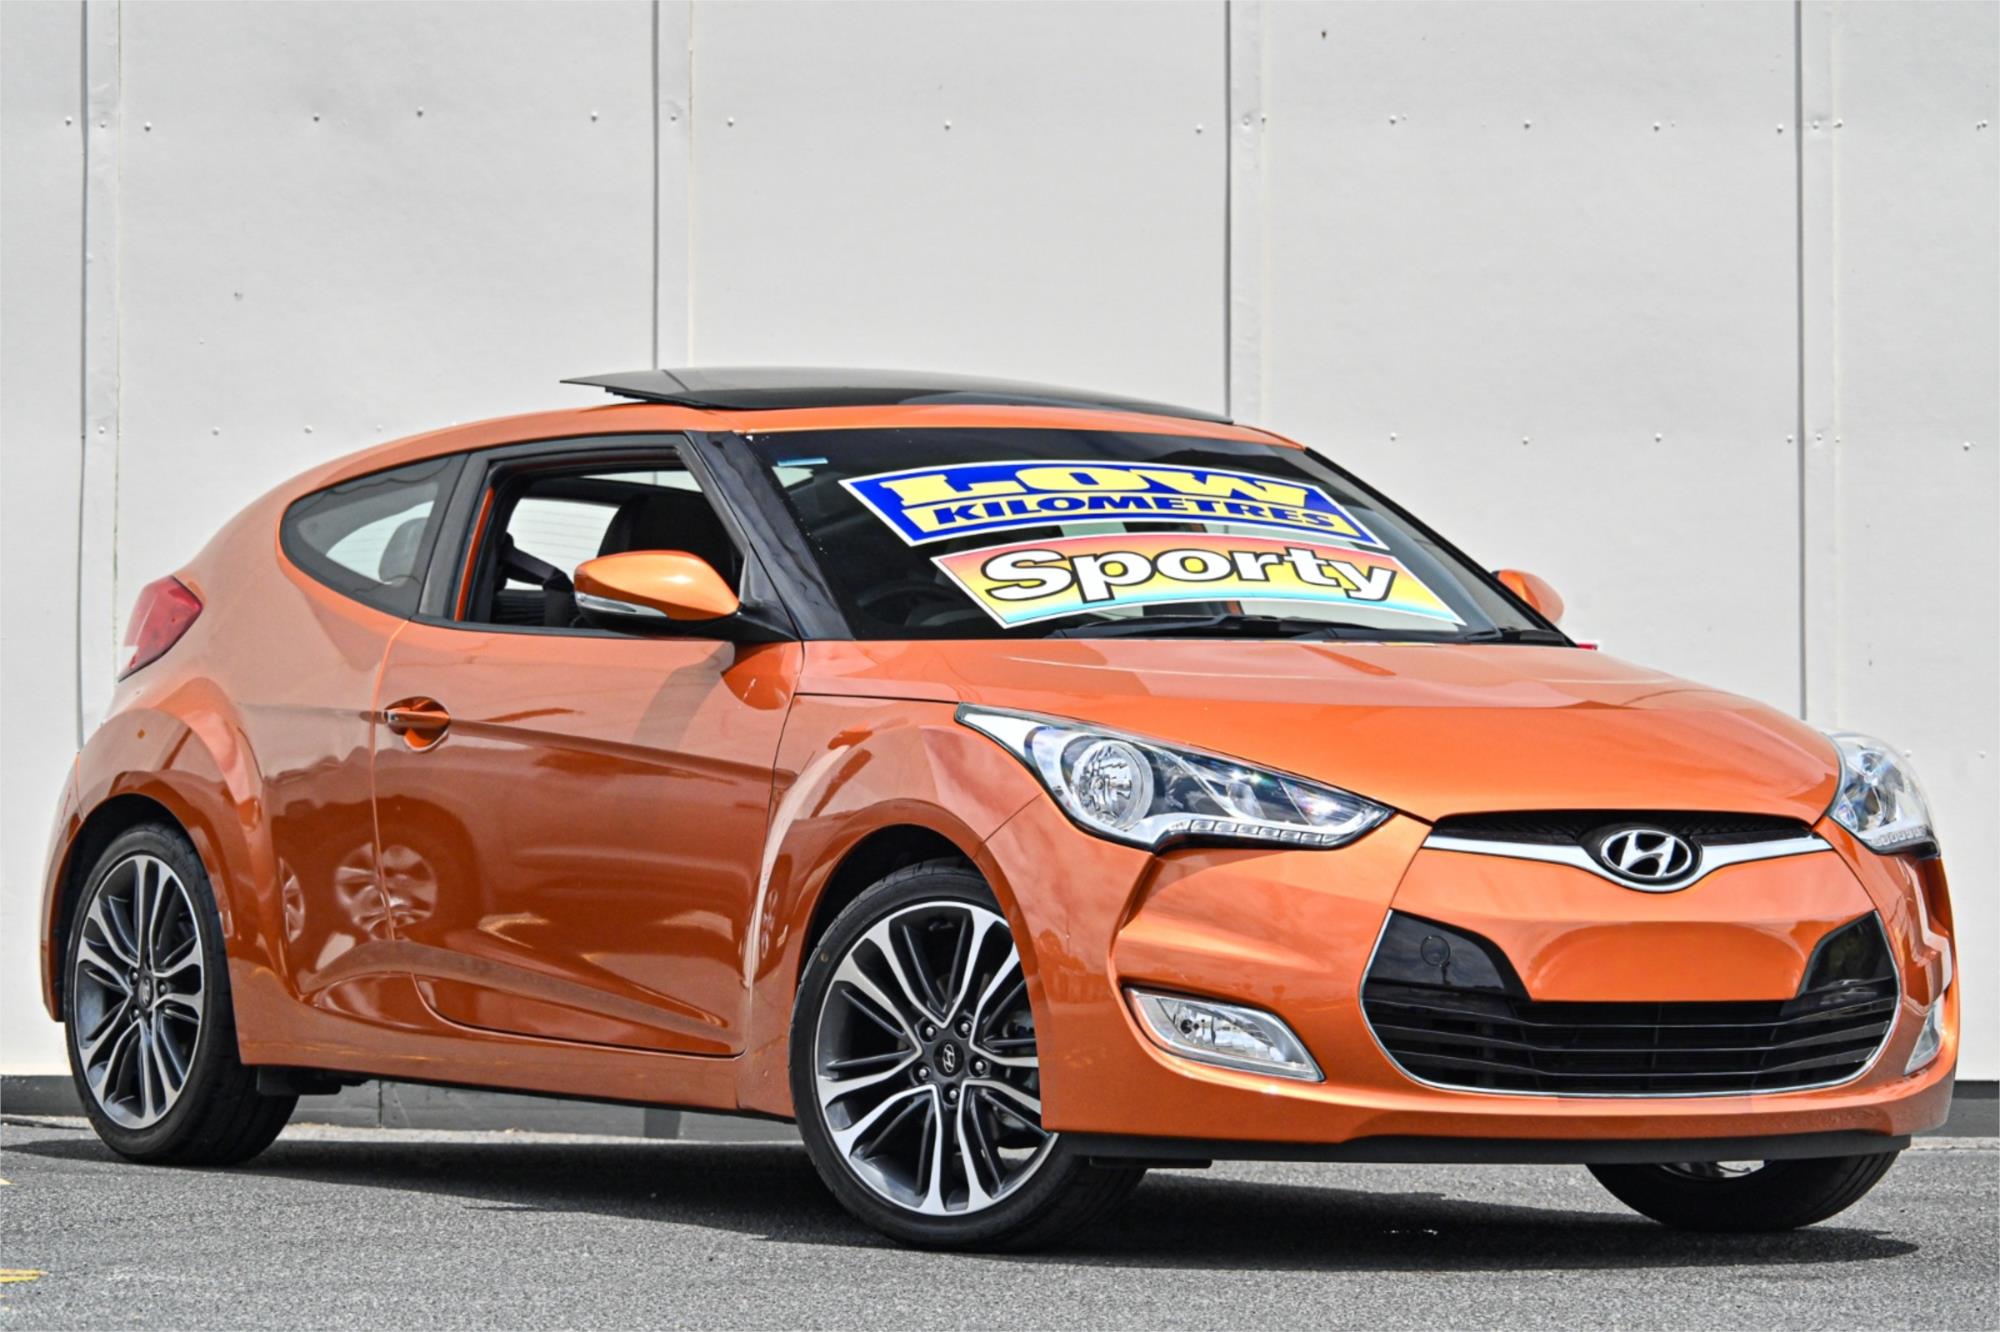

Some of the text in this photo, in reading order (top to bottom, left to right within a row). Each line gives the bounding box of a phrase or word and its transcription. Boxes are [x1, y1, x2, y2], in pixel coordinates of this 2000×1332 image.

[879, 466, 1308, 508] LOW
[933, 495, 1335, 527] KILOMETRES
[981, 547, 1397, 603] Sporty
